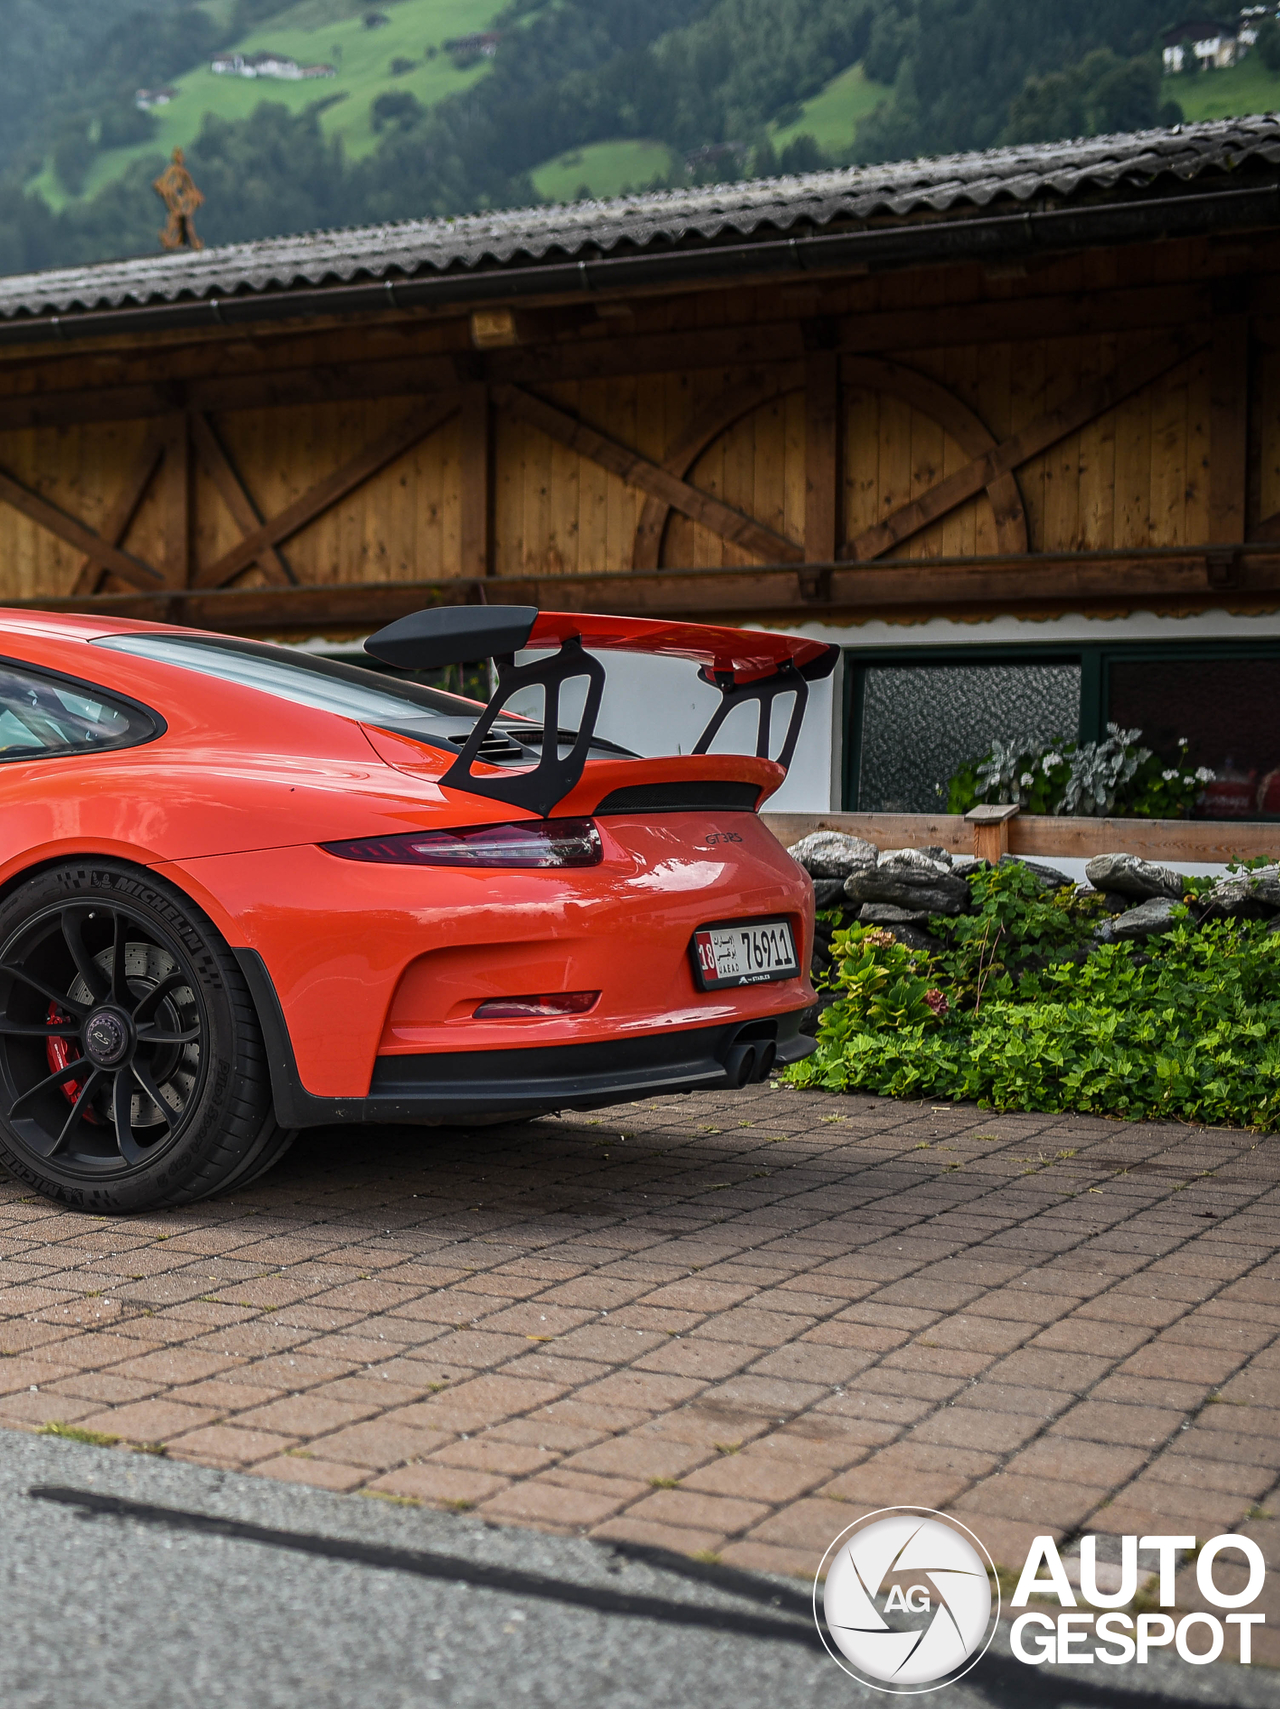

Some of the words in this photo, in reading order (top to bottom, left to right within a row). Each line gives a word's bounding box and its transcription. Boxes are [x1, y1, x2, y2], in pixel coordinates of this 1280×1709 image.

[114, 876, 204, 951] MICHELIN
[698, 943, 715, 971] 18
[740, 928, 793, 971] 76911
[92, 1030, 111, 1046] RS
[213, 1058, 230, 1105] Pilot
[191, 1105, 219, 1156] Sport
[167, 1152, 194, 1176] Cup
